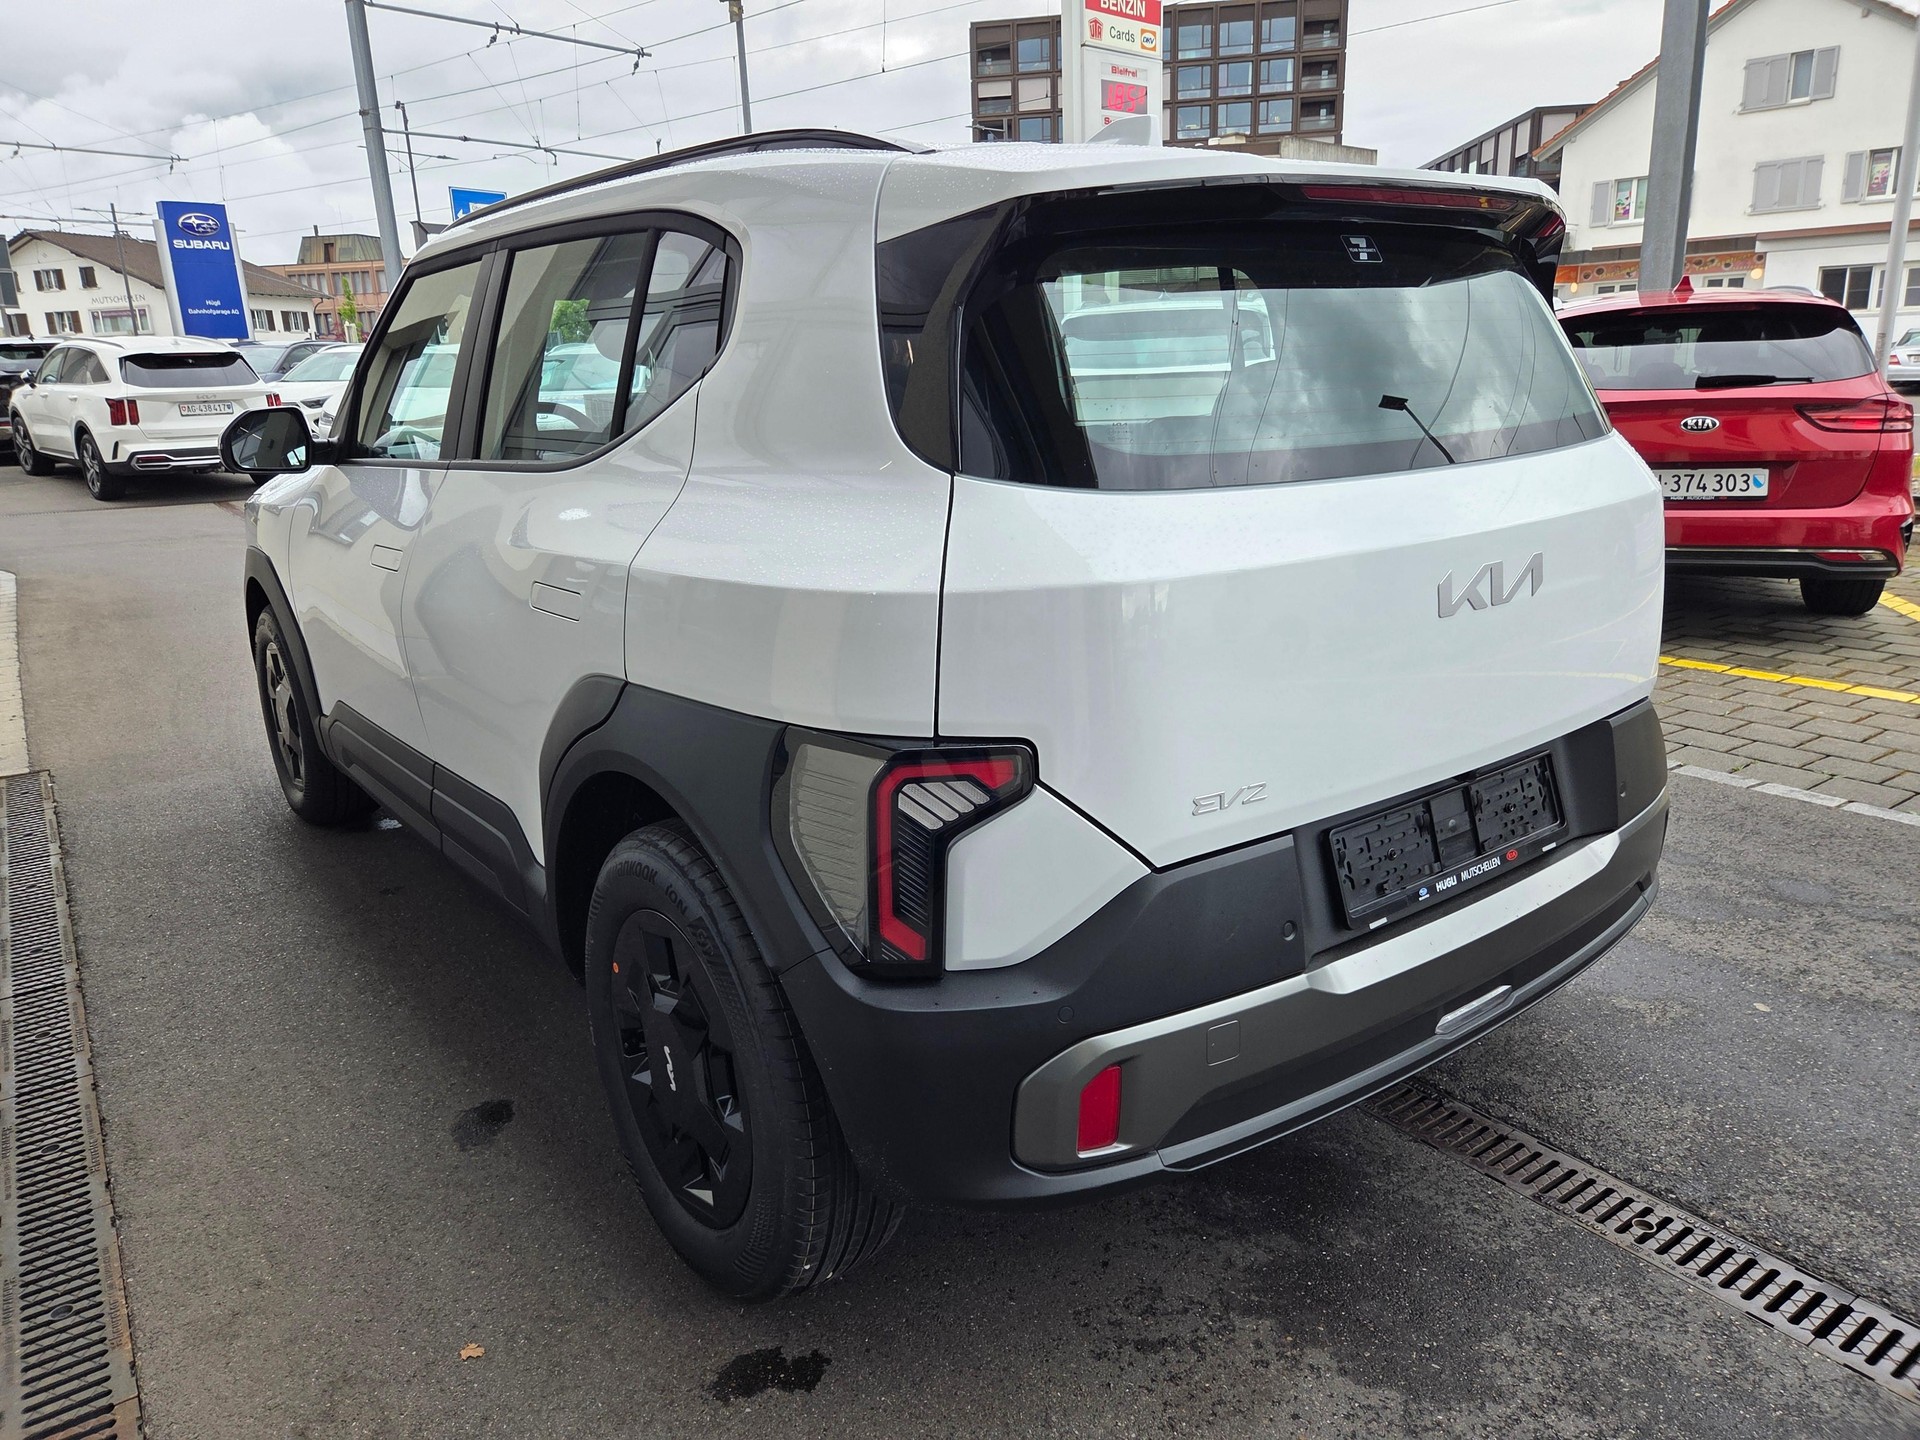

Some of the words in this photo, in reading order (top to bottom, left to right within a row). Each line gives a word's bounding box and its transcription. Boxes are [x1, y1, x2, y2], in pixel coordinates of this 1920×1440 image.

[1100, 0, 1145, 17] BENZIN
[1109, 25, 1135, 43] Cards
[1111, 66, 1137, 78] Bleifrei
[173, 239, 230, 250] SUBARU
[1687, 418, 1713, 429] KIA
[1437, 551, 1543, 619] KIA
[1460, 856, 1501, 882] MUTSCHELLEN
